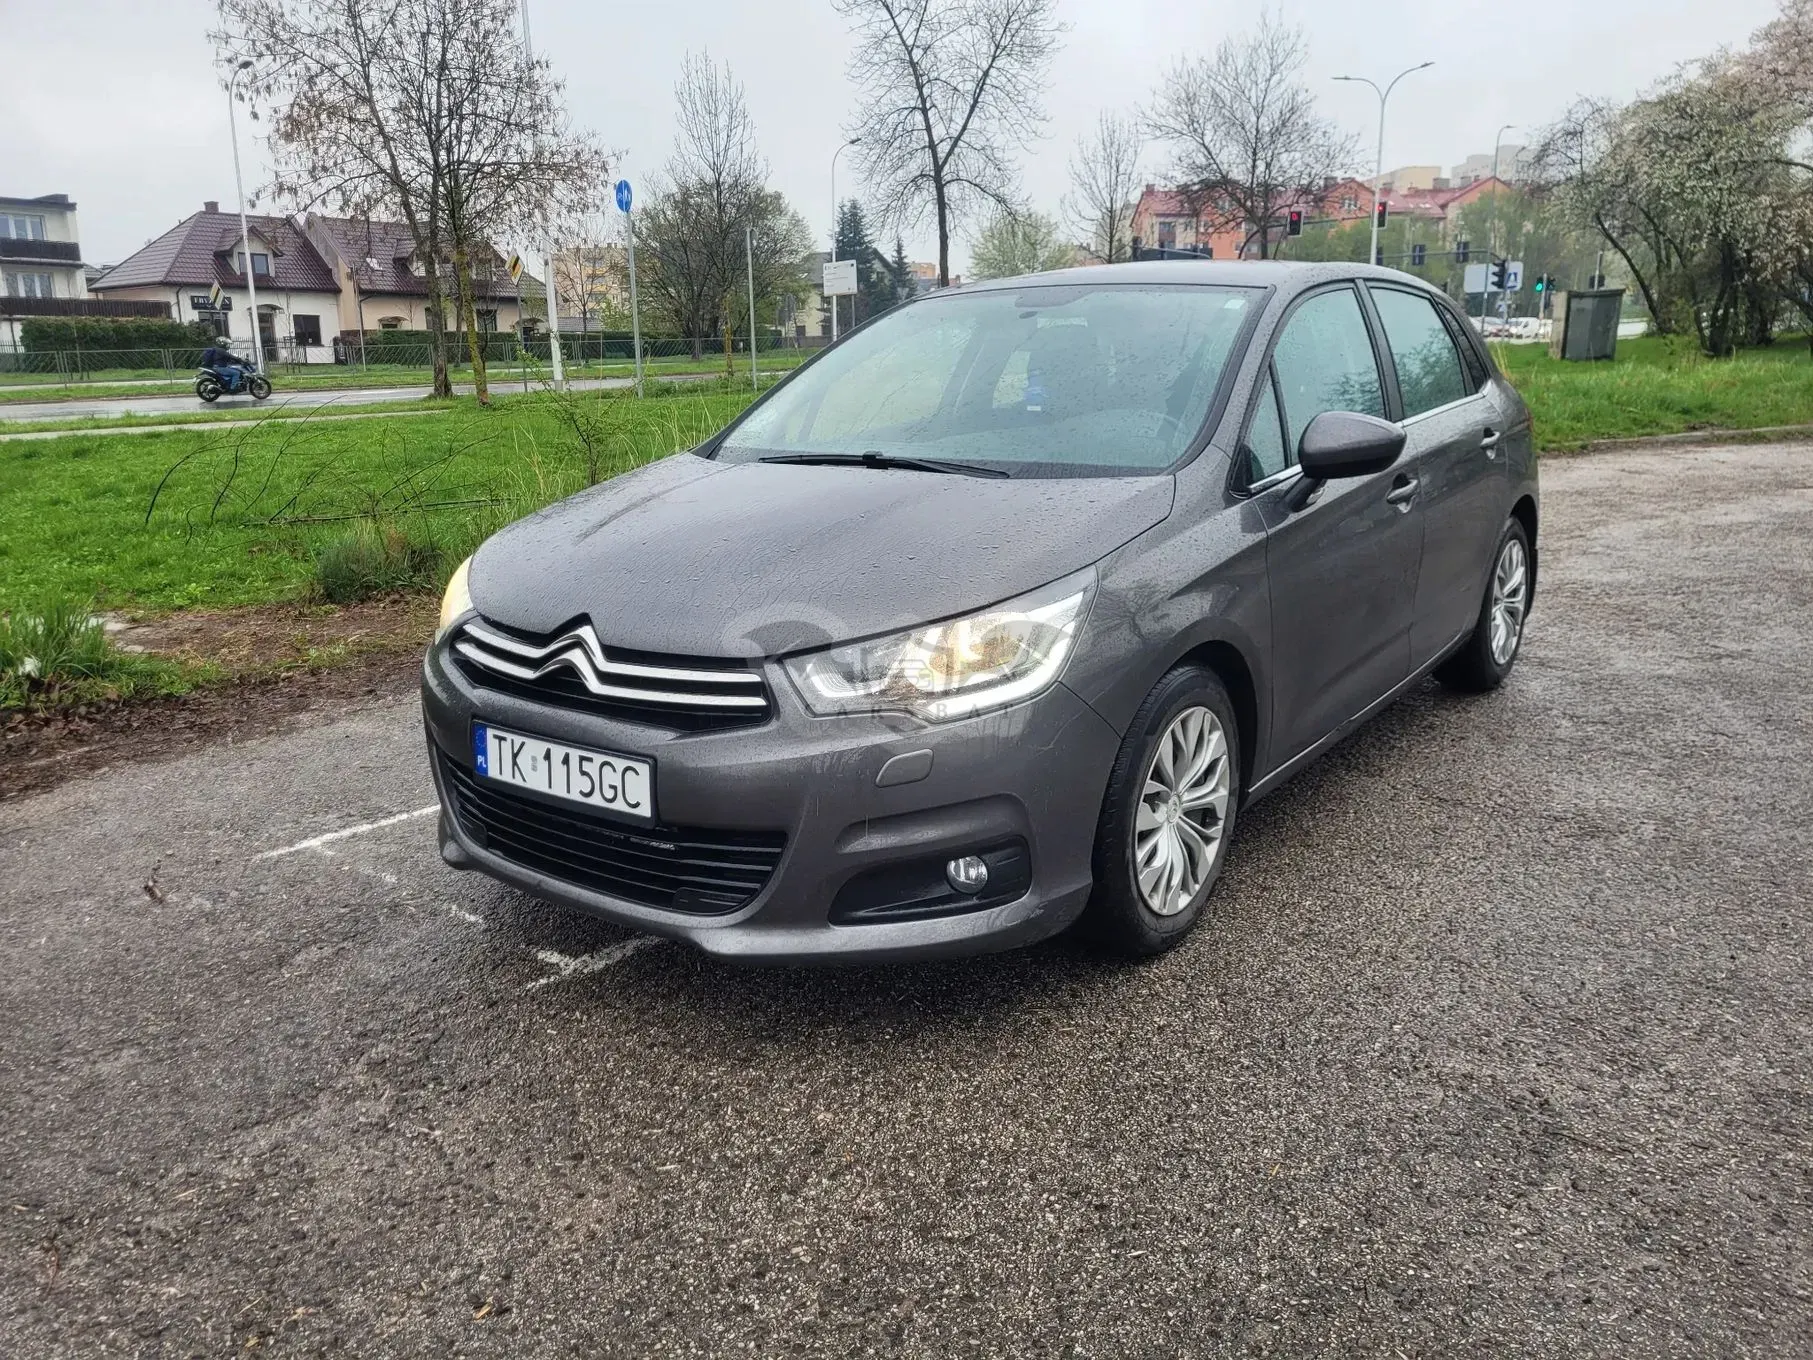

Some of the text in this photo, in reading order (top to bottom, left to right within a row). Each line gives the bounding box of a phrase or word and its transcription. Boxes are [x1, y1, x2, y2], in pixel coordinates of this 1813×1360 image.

[477, 755, 487, 768] PL
[492, 733, 641, 809] TK 115GC
